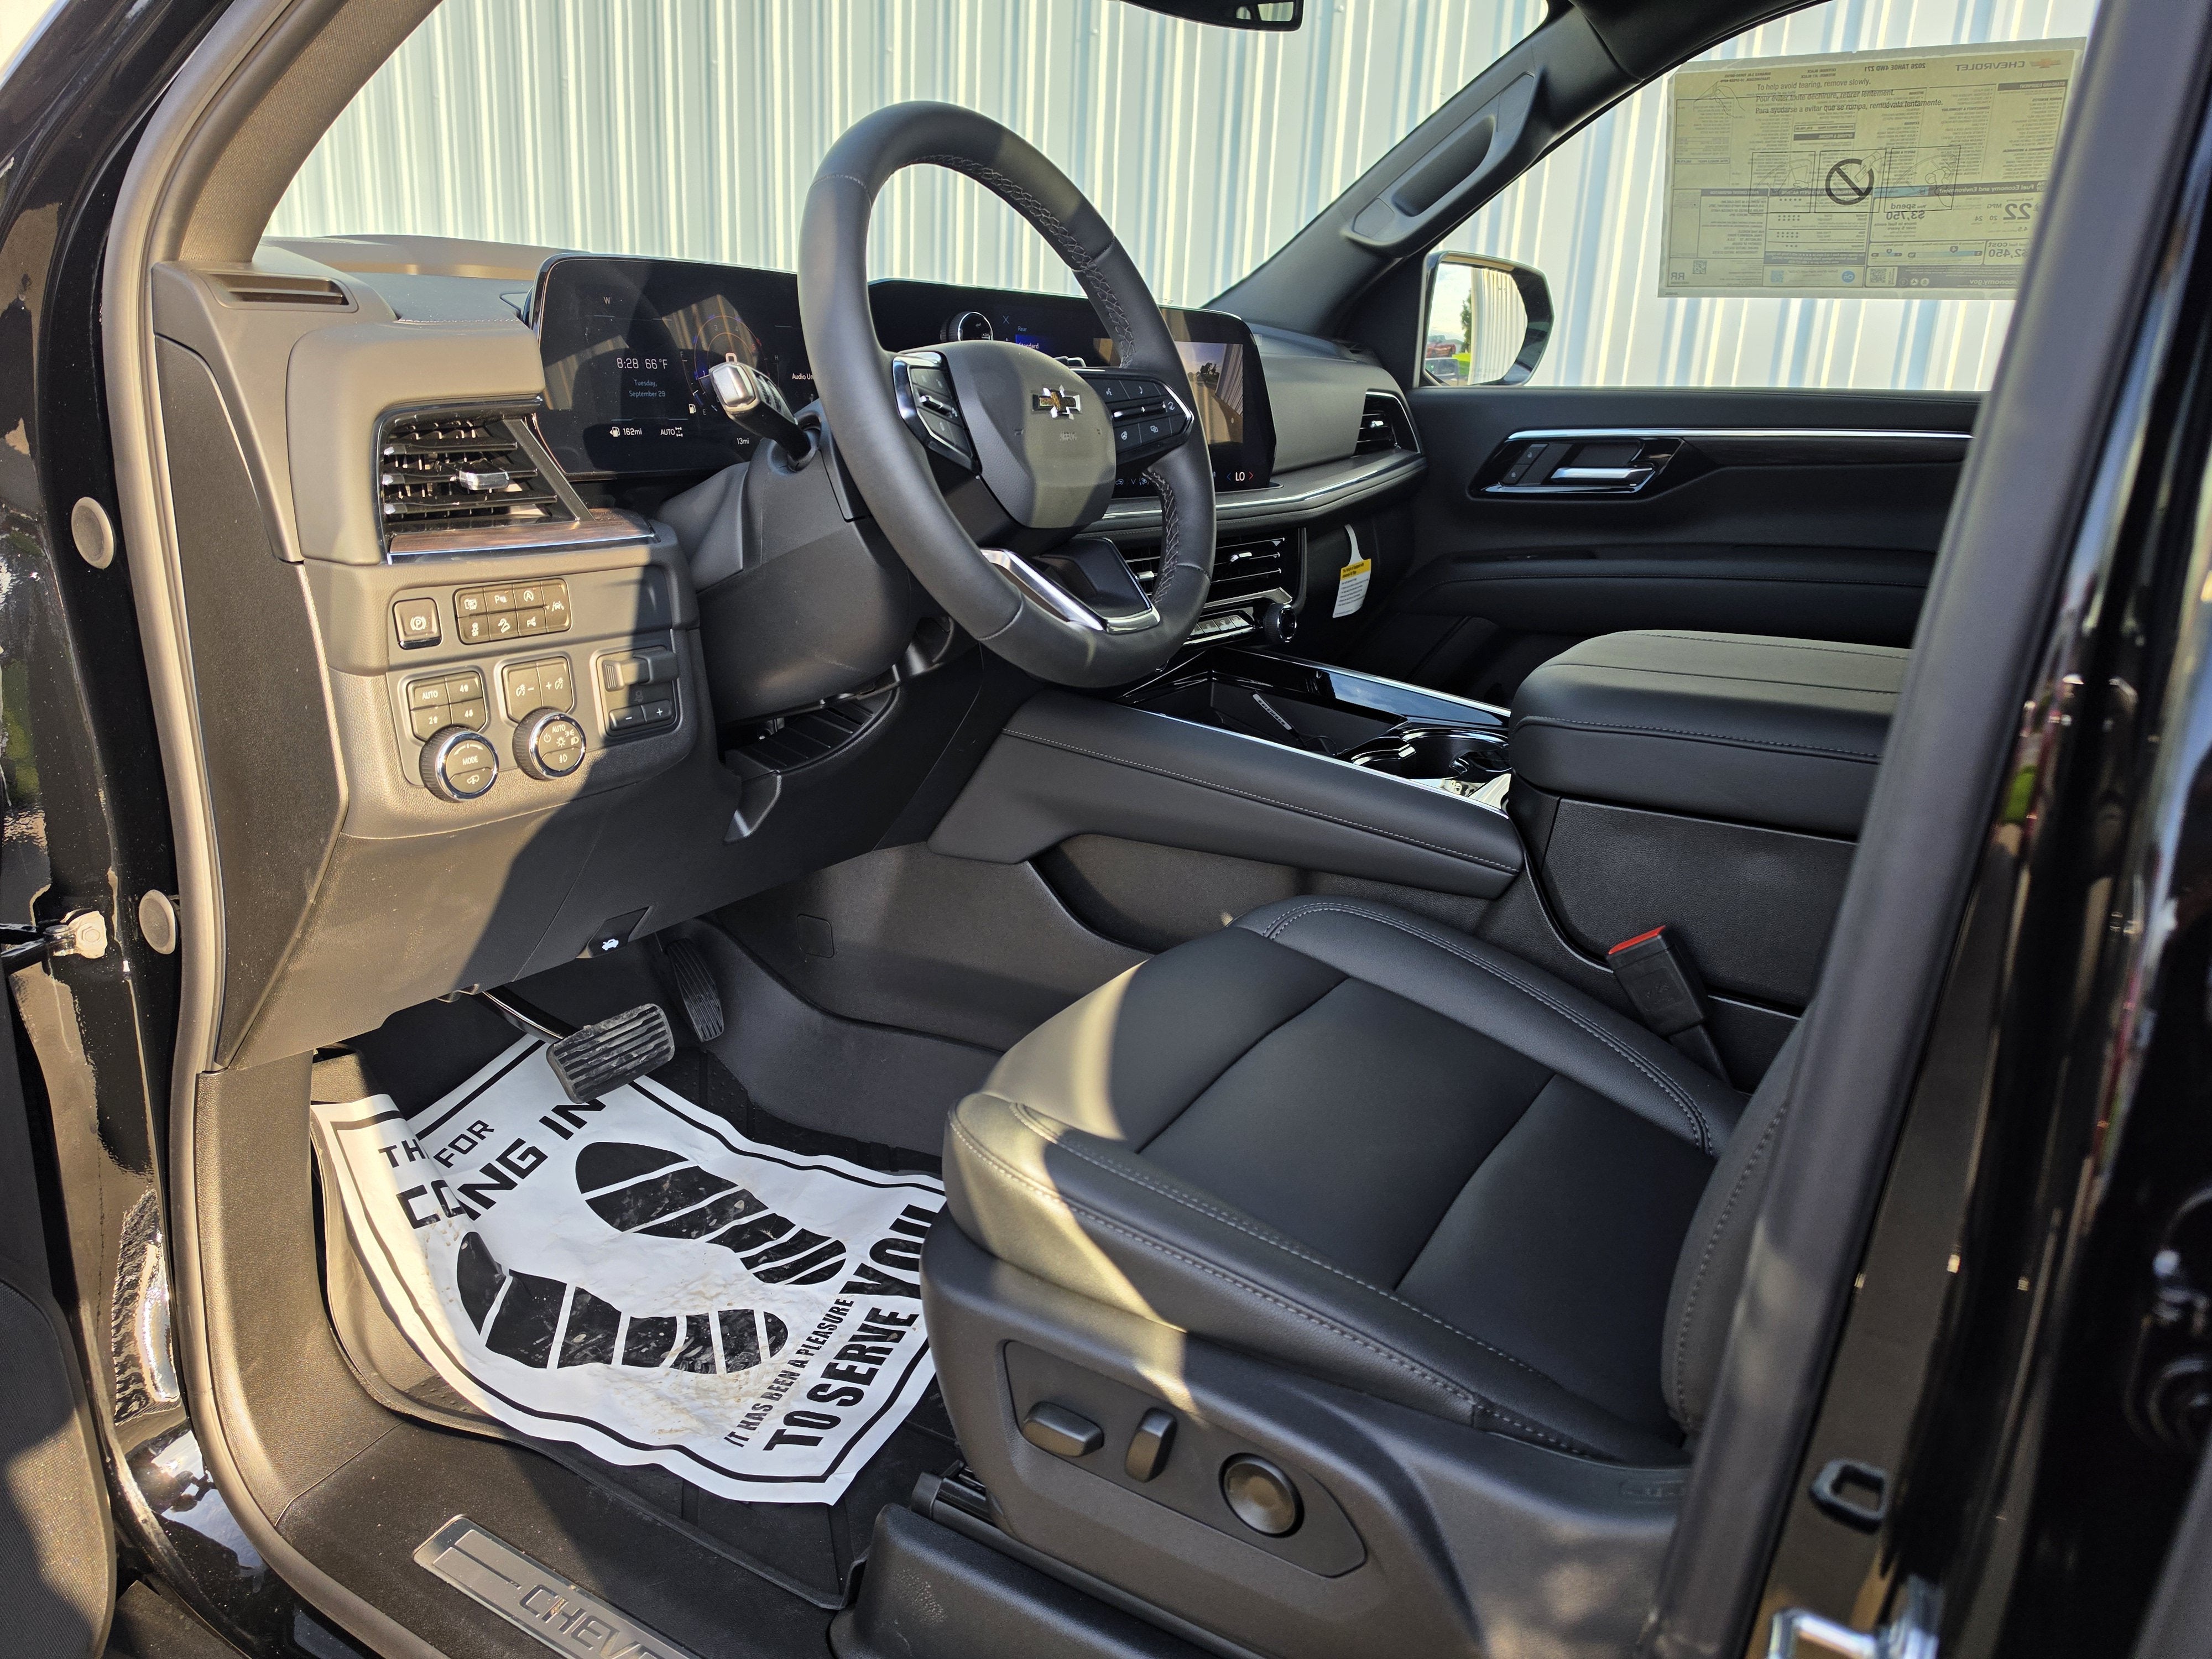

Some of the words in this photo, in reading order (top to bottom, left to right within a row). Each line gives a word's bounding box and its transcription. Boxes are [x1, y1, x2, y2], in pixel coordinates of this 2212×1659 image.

[1766, 83, 1779, 91] help
[1780, 81, 1797, 90] avoid
[1770, 106, 1797, 115] ayudarse
[1905, 99, 1943, 108] lentamente.
[616, 357, 639, 369] 8:28
[633, 379, 658, 387] Tuesday,
[622, 427, 642, 436] 162mi
[1235, 471, 1245, 482] LO
[422, 690, 439, 700] AUTO
[552, 724, 566, 734] AUTO
[462, 755, 479, 765] MODE
[539, 1098, 607, 1141] IN
[433, 1120, 495, 1168] FOR
[838, 1203, 938, 1300] YOU
[795, 1298, 855, 1357] PLEASURE
[787, 1359, 810, 1369] A
[806, 1306, 920, 1407] SERVE
[760, 1369, 801, 1401] BEEN
[737, 1402, 774, 1431] HAS
[762, 1410, 842, 1451] TO
[723, 1431, 750, 1448] IT
